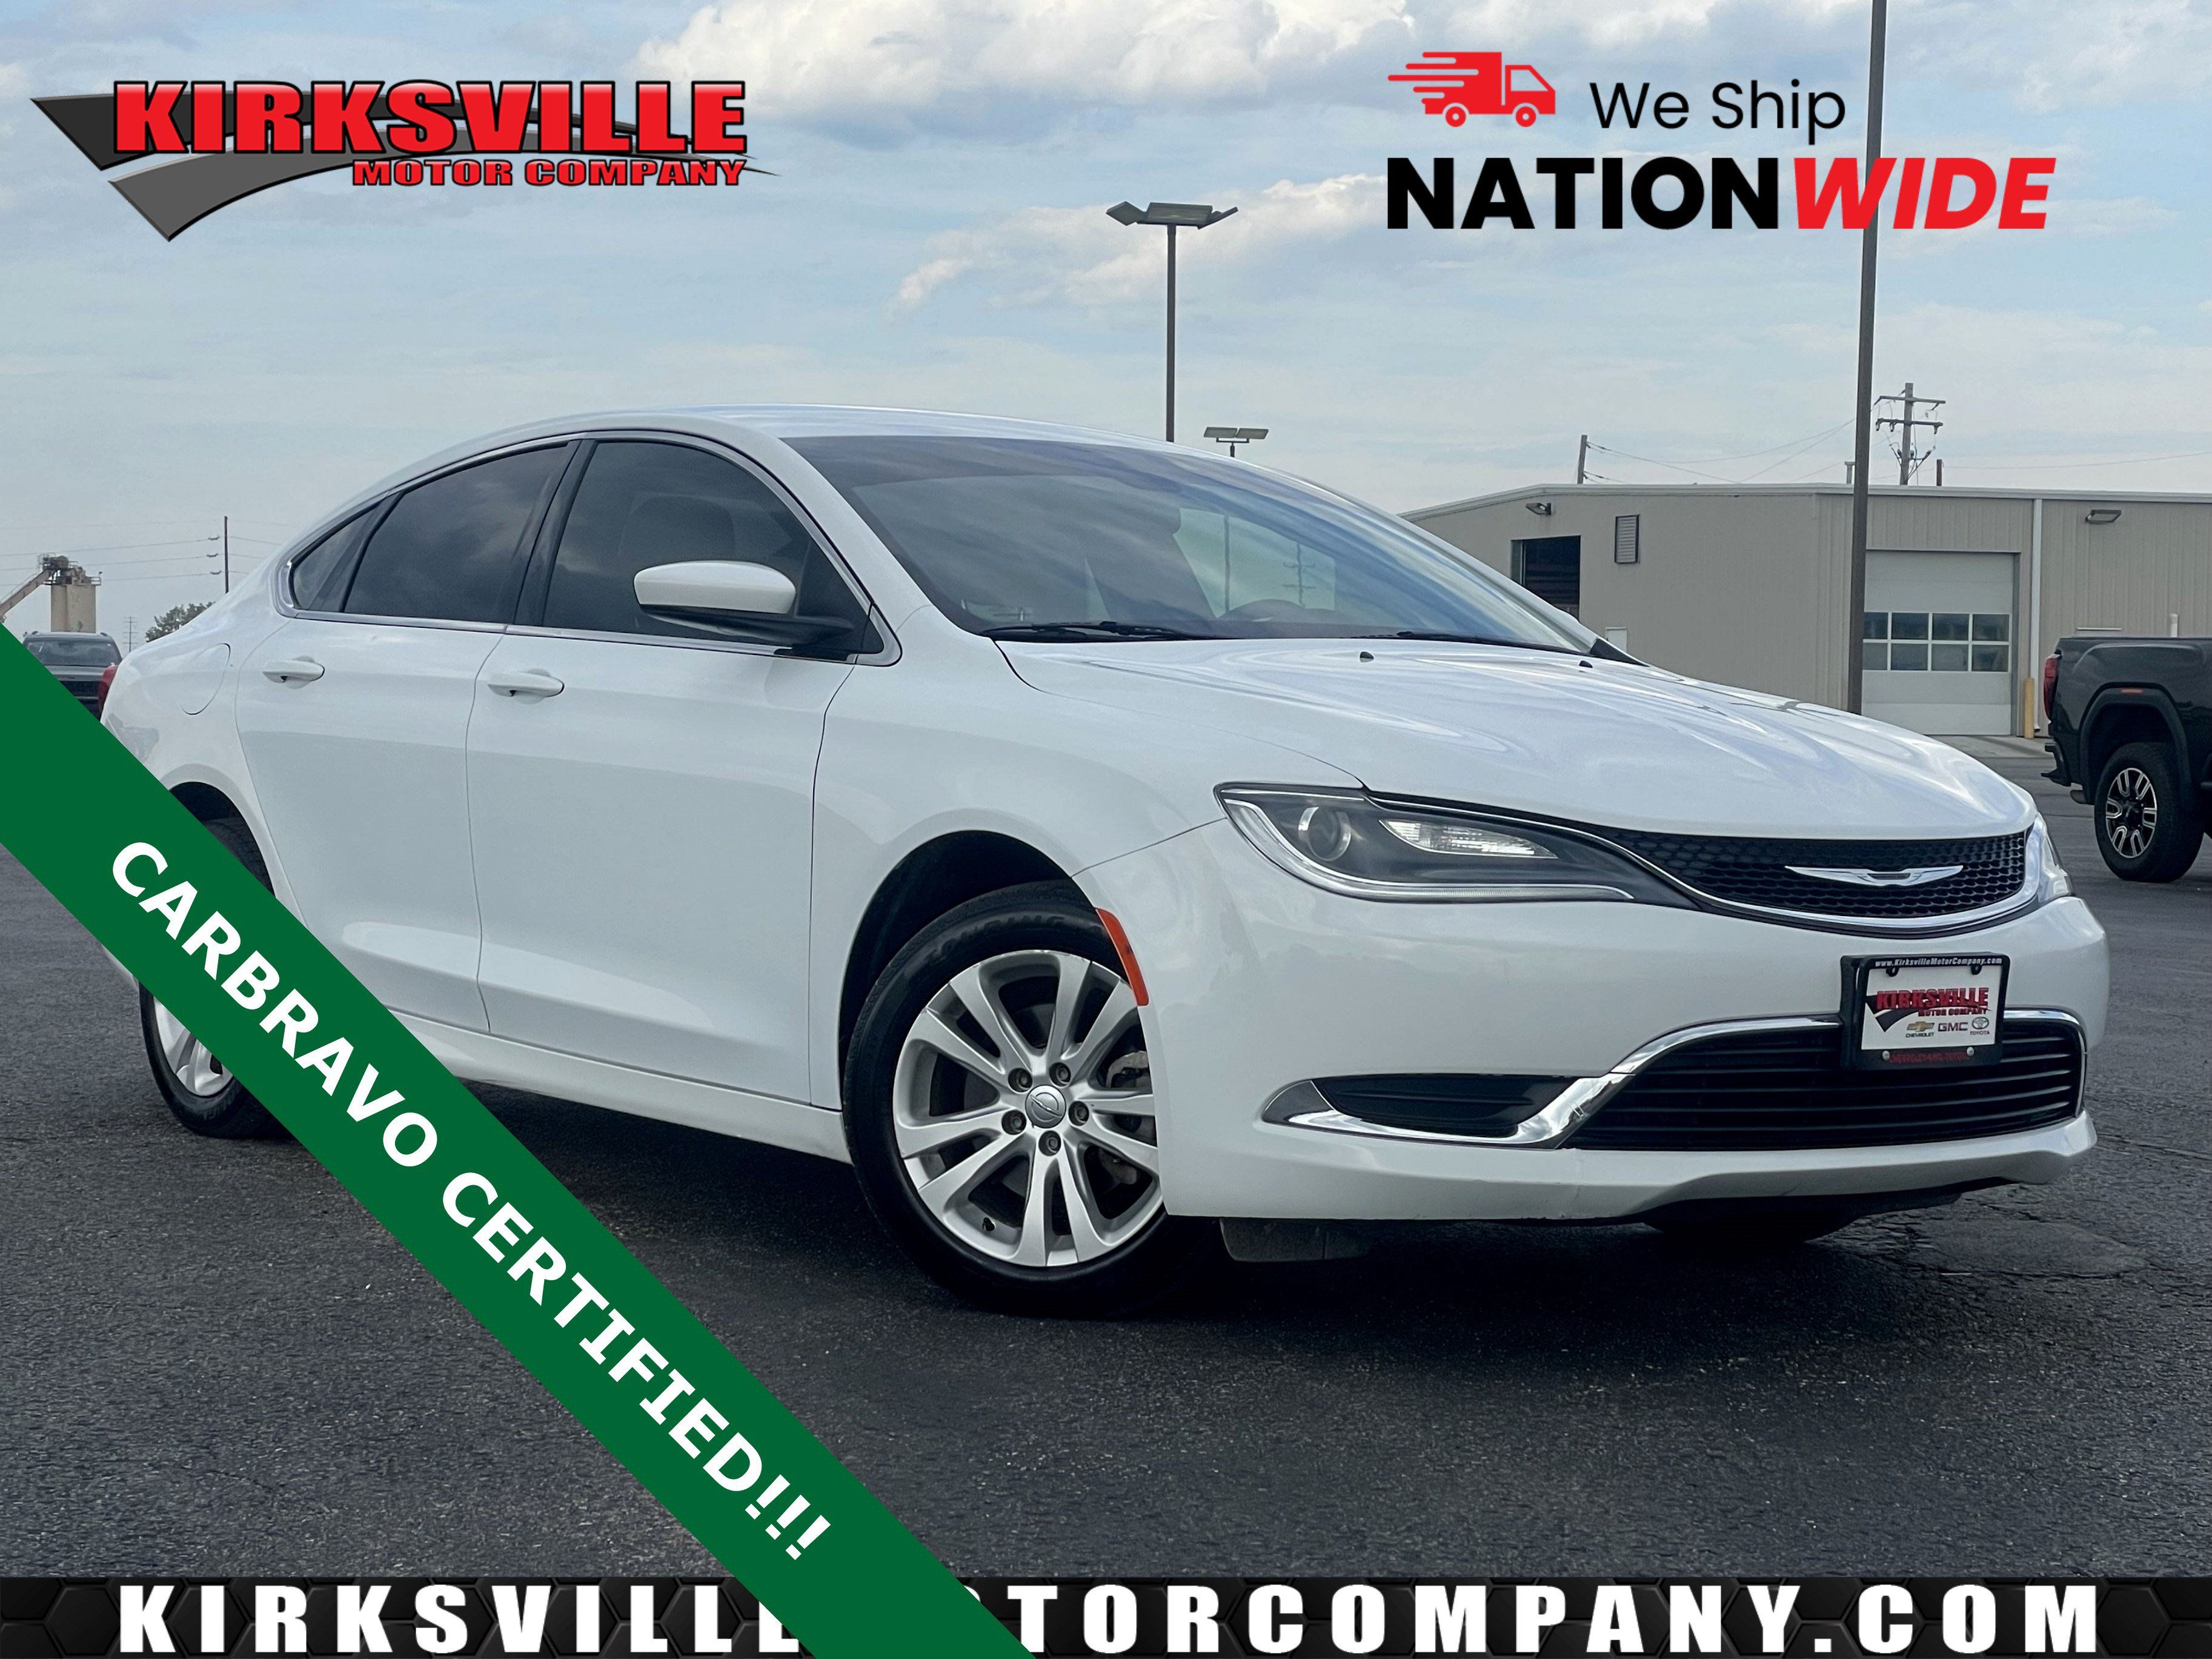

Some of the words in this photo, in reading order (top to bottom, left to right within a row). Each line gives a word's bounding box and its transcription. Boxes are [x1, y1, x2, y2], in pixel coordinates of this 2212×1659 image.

[1876, 957, 2002, 967] www.KirksvilleMotorCompany.com
[1876, 987, 1989, 1009] KIRKSVILLE
[1918, 1008, 1947, 1017] MOTOR
[1948, 1007, 1987, 1016] COMPANY
[1938, 1022, 1968, 1032] GMC
